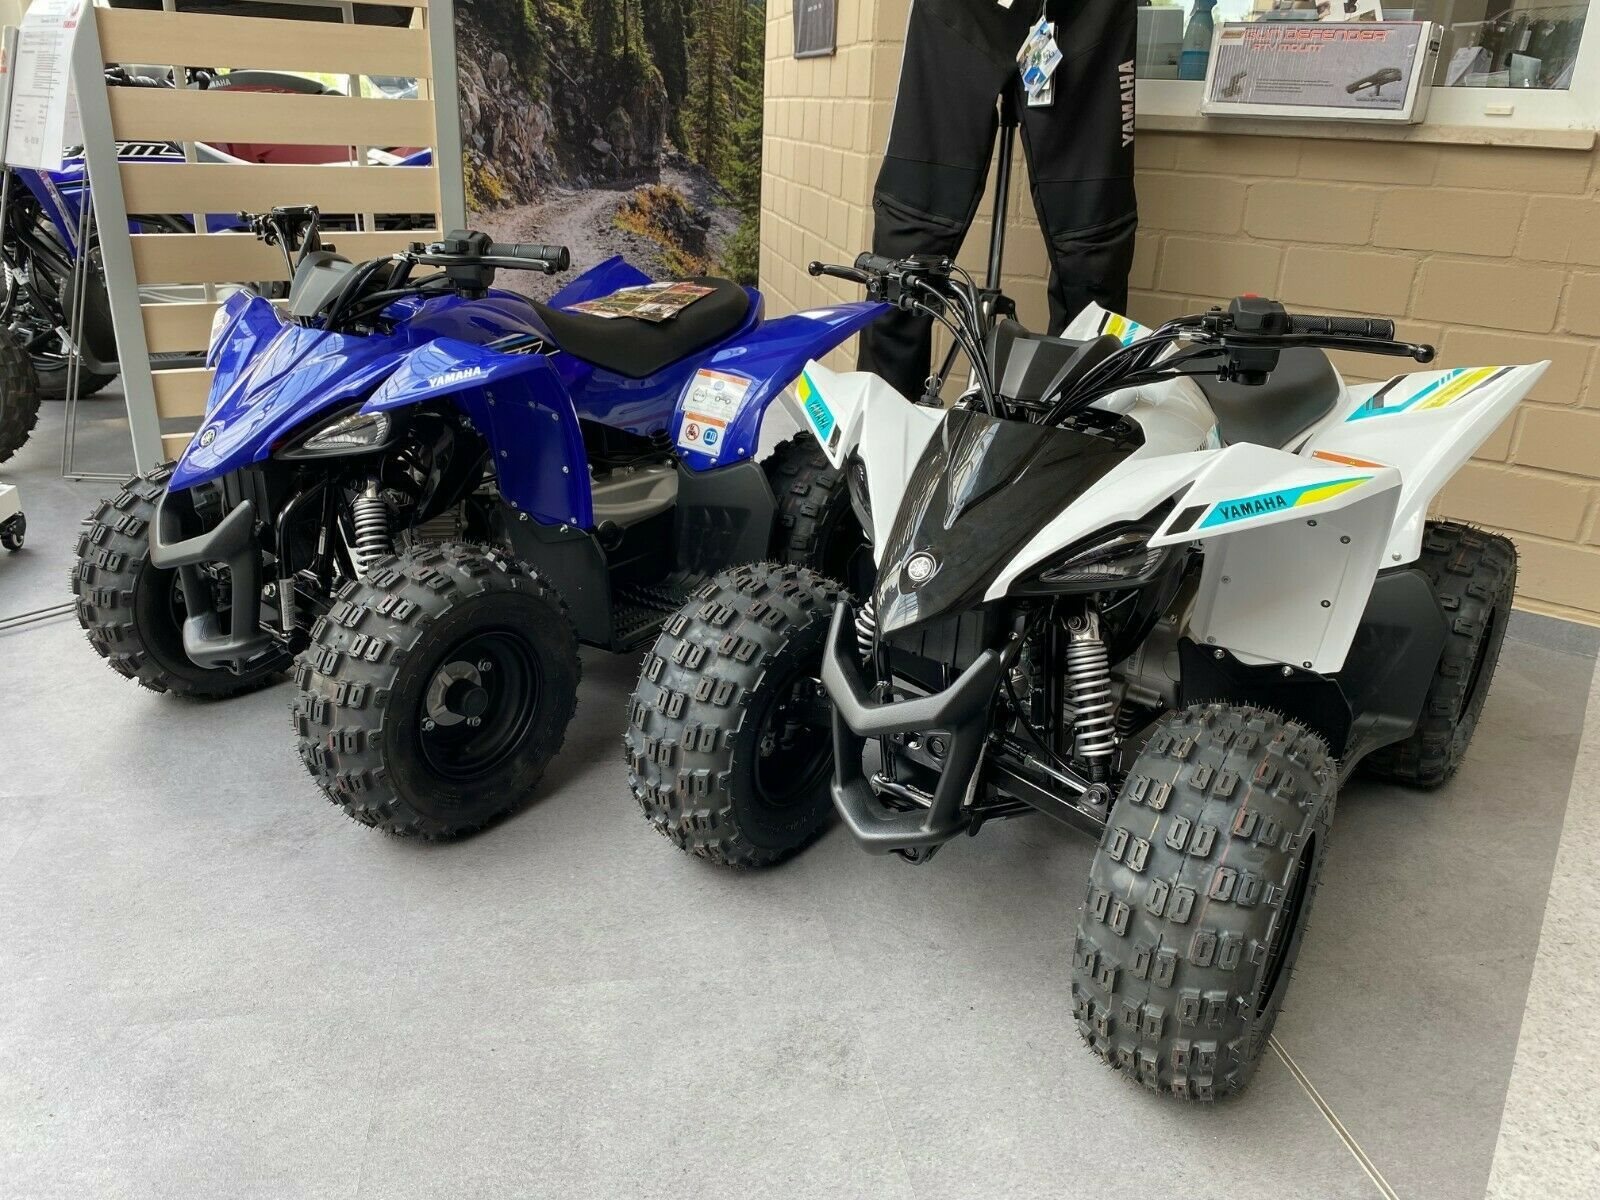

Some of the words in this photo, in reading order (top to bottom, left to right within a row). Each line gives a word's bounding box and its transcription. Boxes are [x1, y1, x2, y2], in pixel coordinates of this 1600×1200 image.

[1283, 28, 1389, 43] DEFENDER
[1118, 59, 1135, 148] YAMAHA
[427, 366, 481, 388] YAMAHA
[809, 400, 831, 430] YAMAHA
[1219, 494, 1288, 520] YAMAHA
